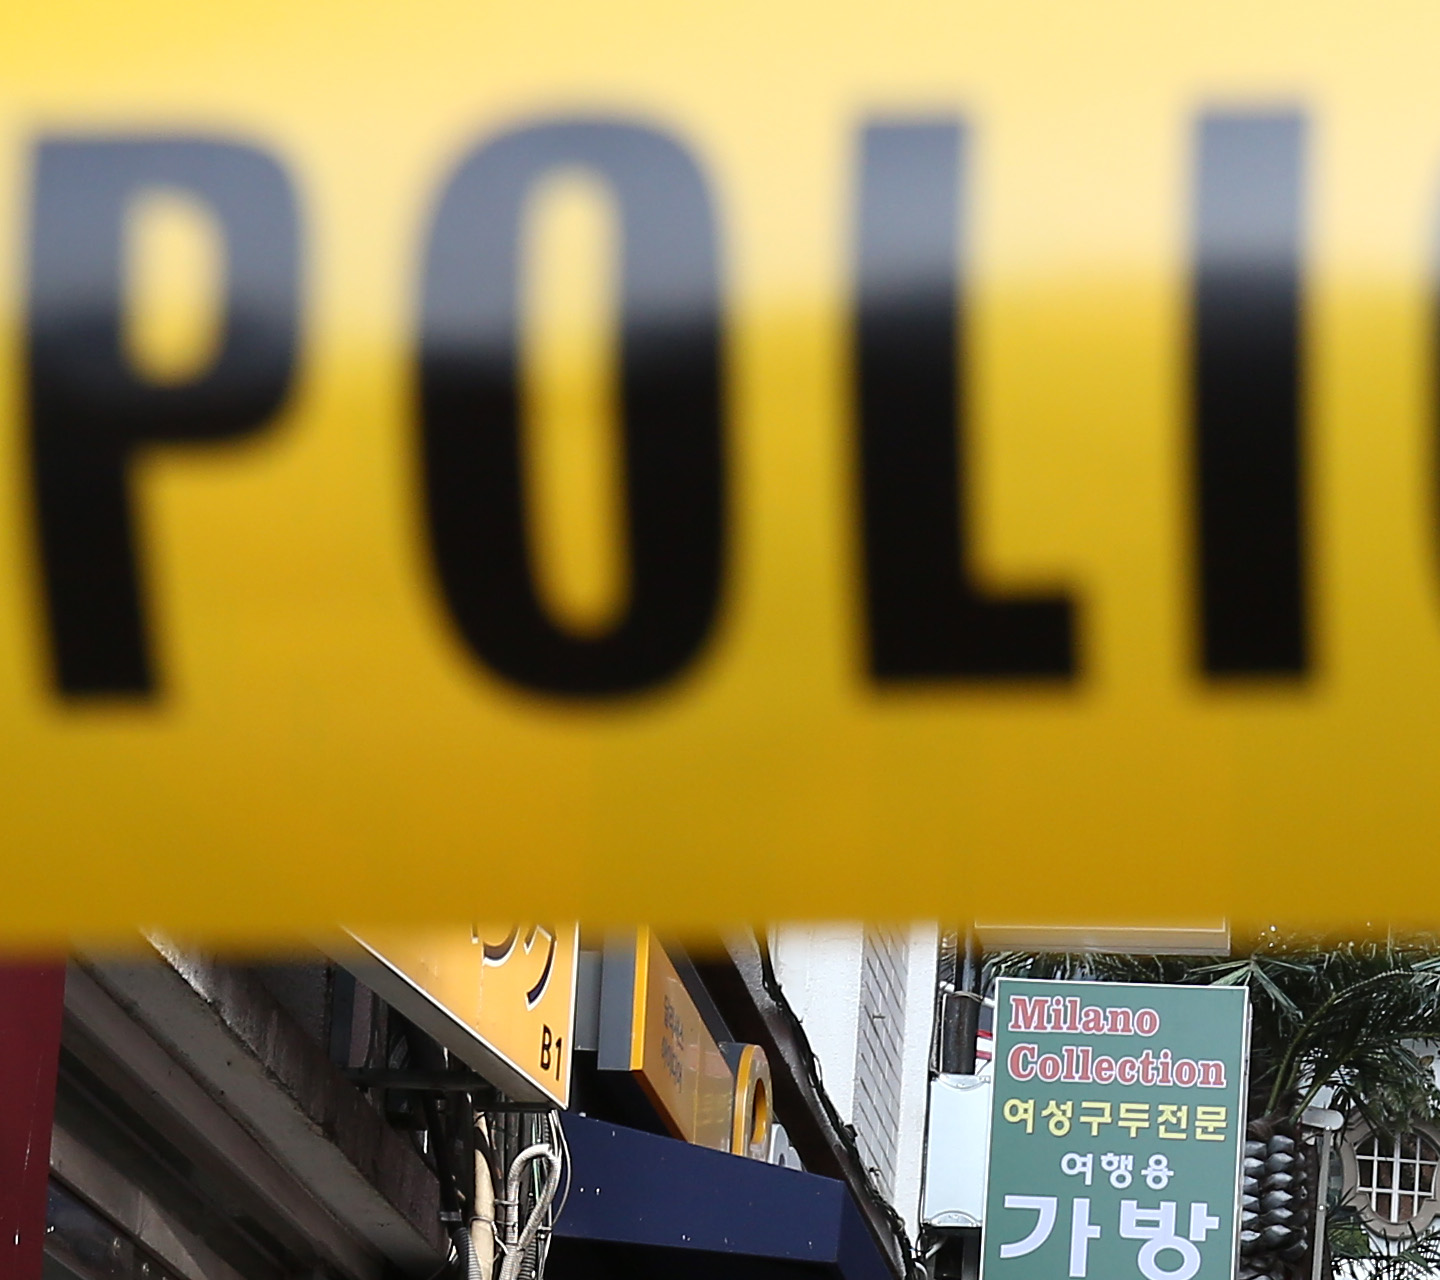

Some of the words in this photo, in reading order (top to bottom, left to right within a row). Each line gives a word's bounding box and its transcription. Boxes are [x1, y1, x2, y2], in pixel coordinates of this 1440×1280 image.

[1008, 995, 1160, 1039] Milano
[540, 1023, 563, 1082] B1
[1007, 1041, 1228, 1089] Collection
[1002, 1095, 1229, 1143] 여성구두전문
[1060, 1150, 1175, 1191] 여행용
